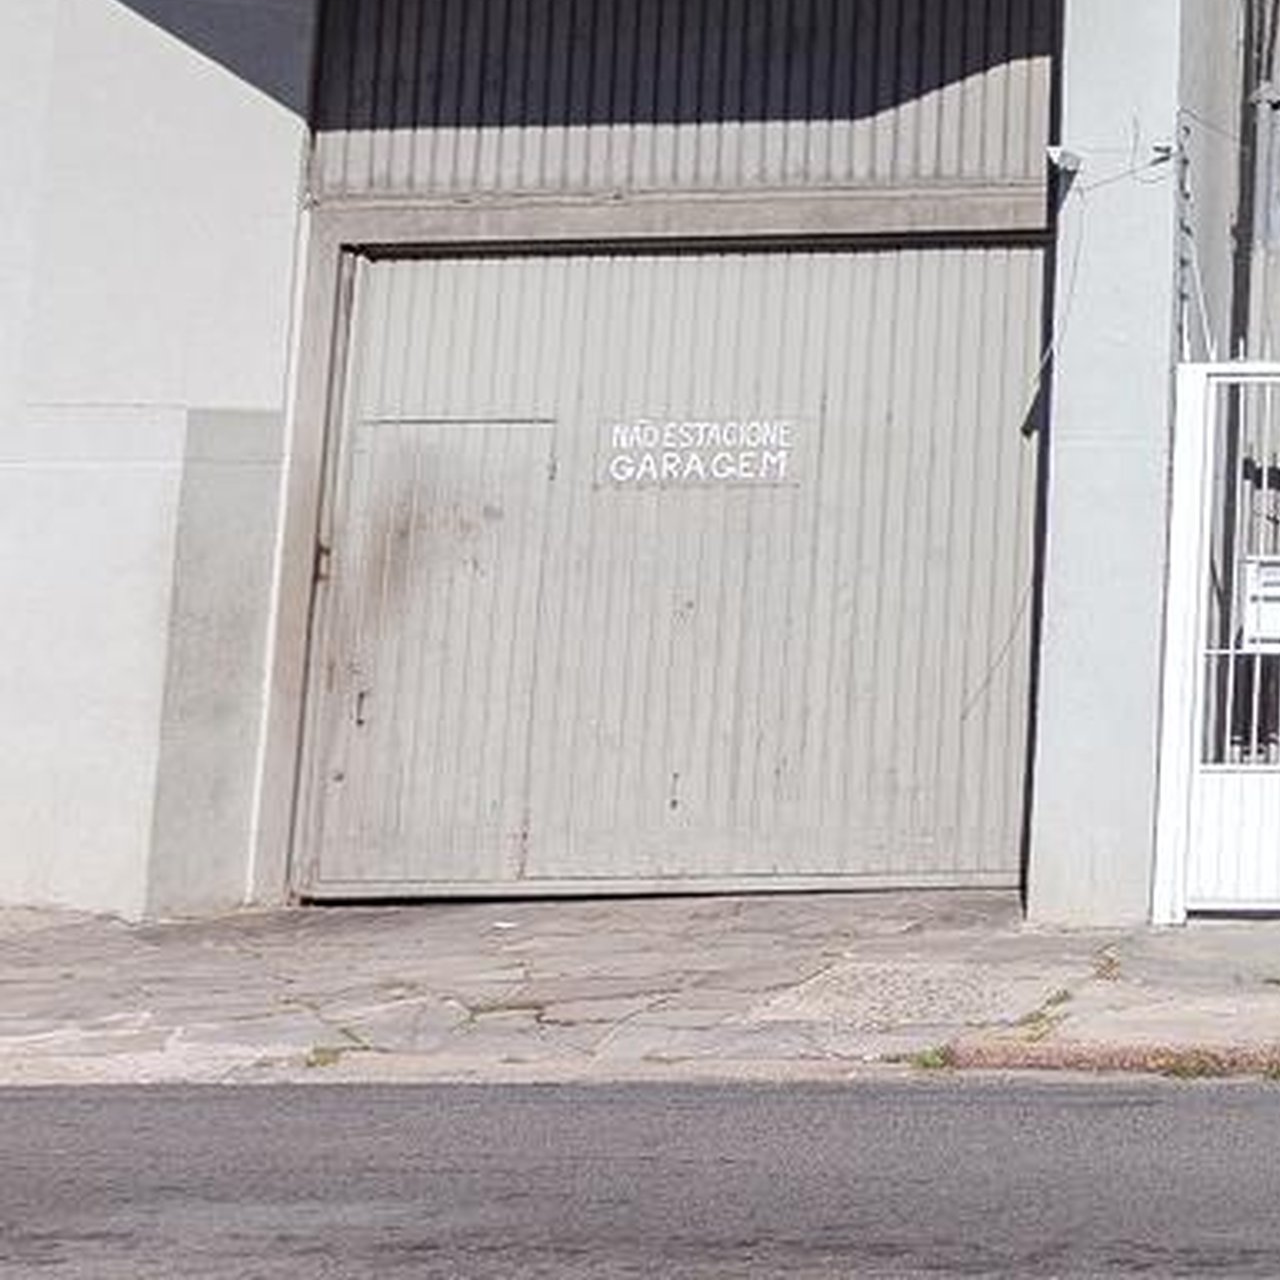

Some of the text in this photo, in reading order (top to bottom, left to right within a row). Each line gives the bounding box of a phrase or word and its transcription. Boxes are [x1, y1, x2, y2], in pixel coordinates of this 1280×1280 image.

[612, 419, 791, 448] NÃO ESTACIONE
[609, 451, 787, 480] GARAGEM
